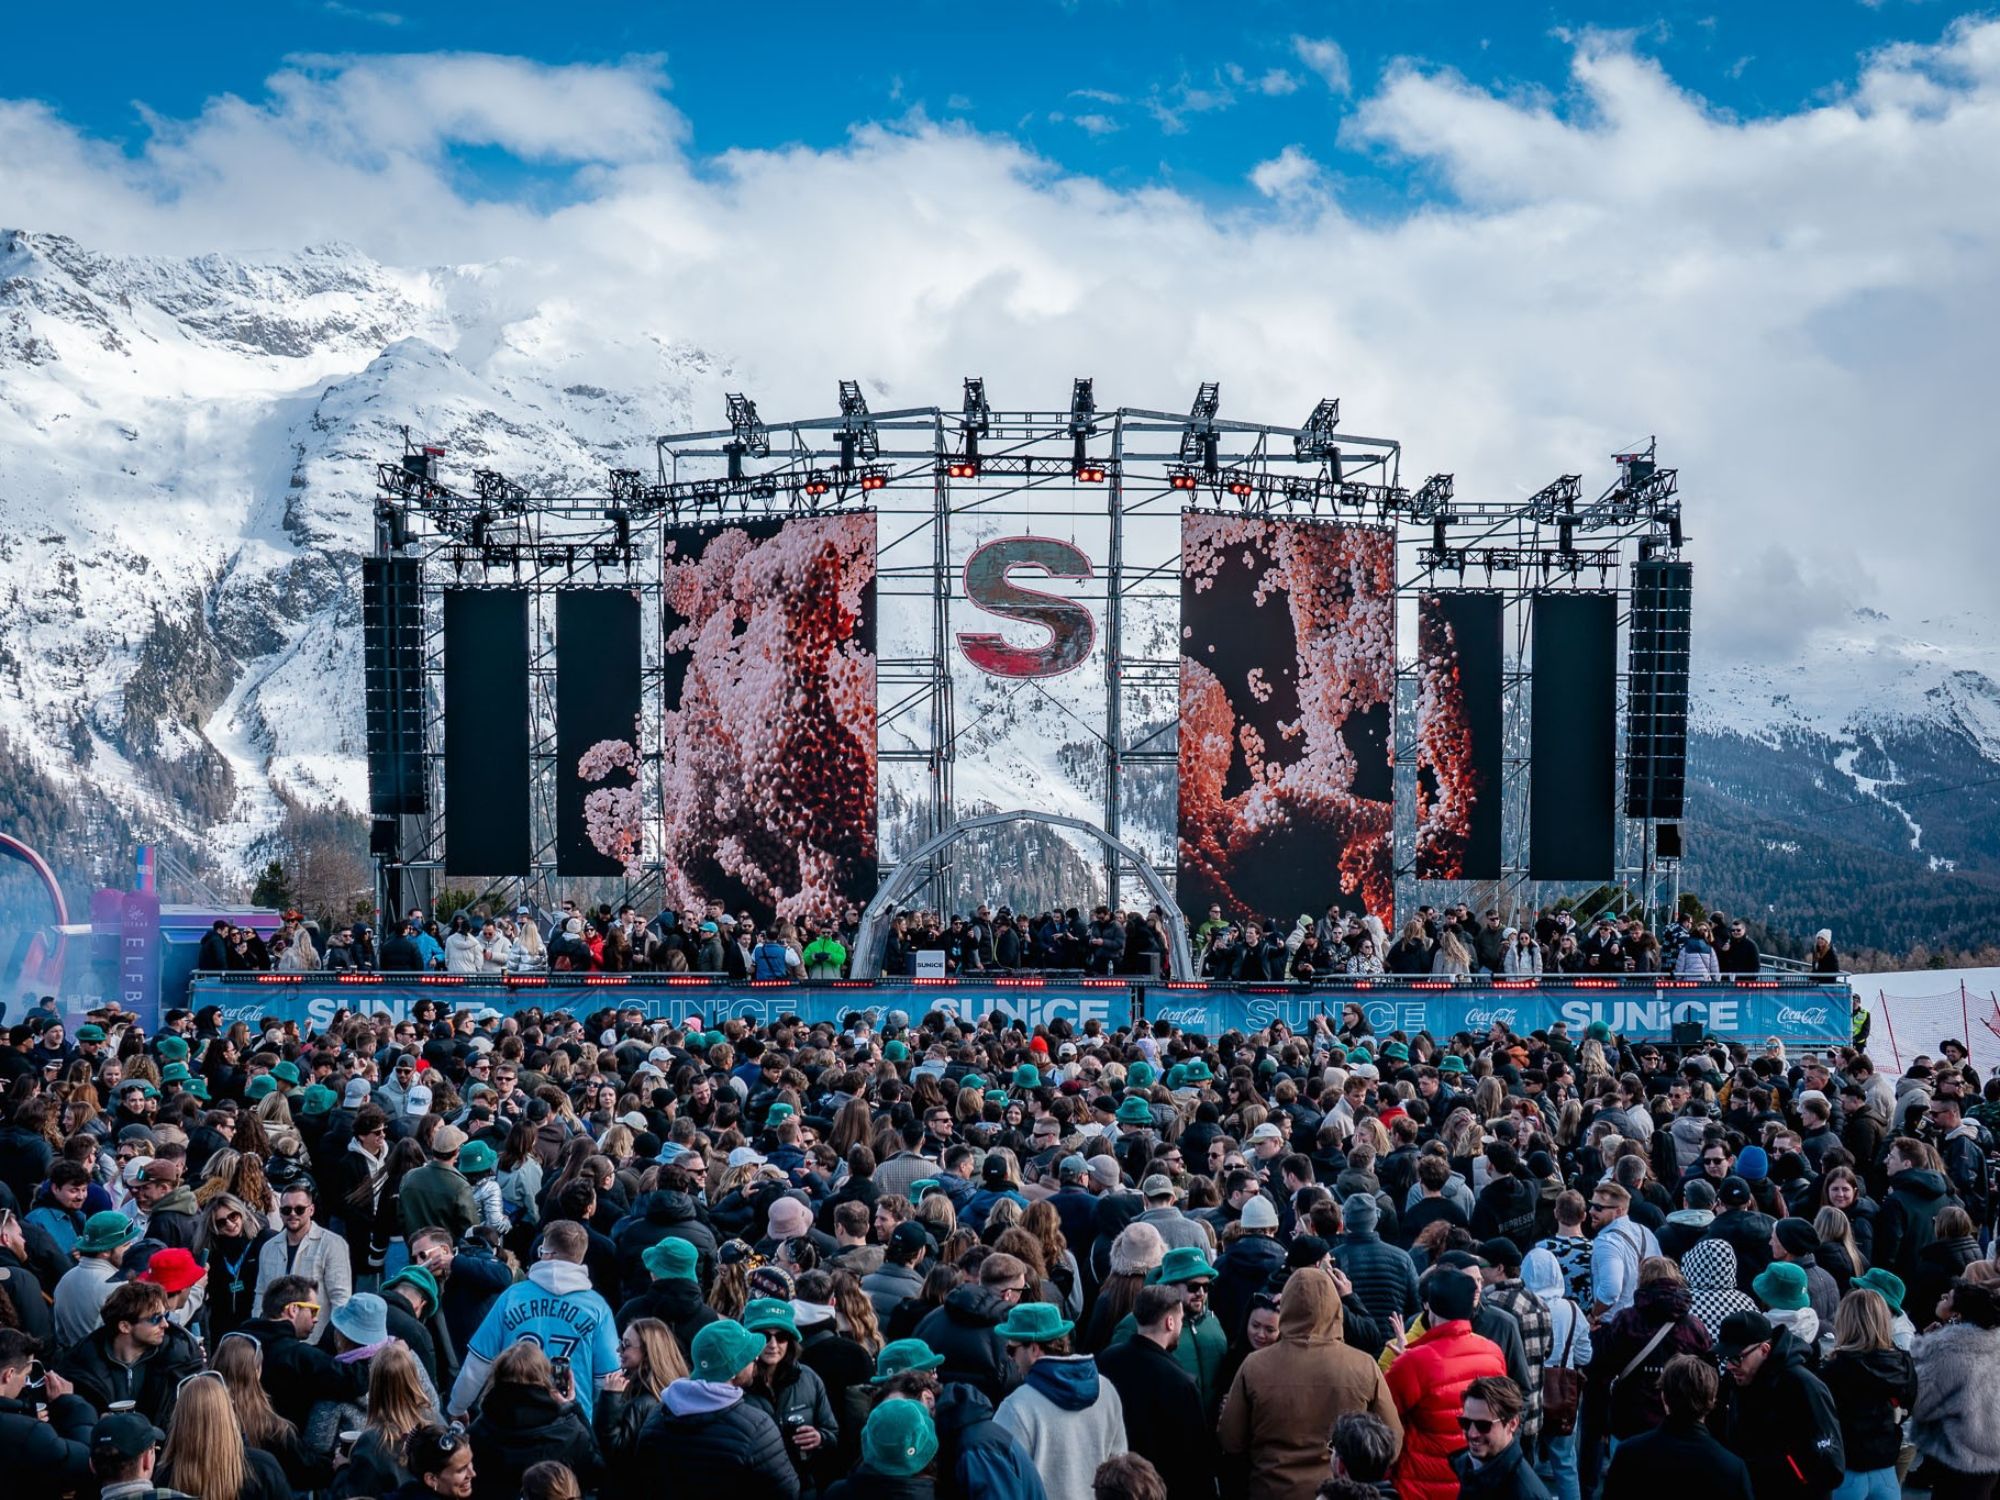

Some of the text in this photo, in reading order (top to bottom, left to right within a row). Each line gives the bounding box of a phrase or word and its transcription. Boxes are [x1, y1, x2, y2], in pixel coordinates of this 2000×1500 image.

[956, 536, 1096, 679] S
[124, 936, 145, 1018] ELFB
[1245, 998, 1426, 1034] SUNCE
[503, 1298, 578, 1332] GUERRERO
